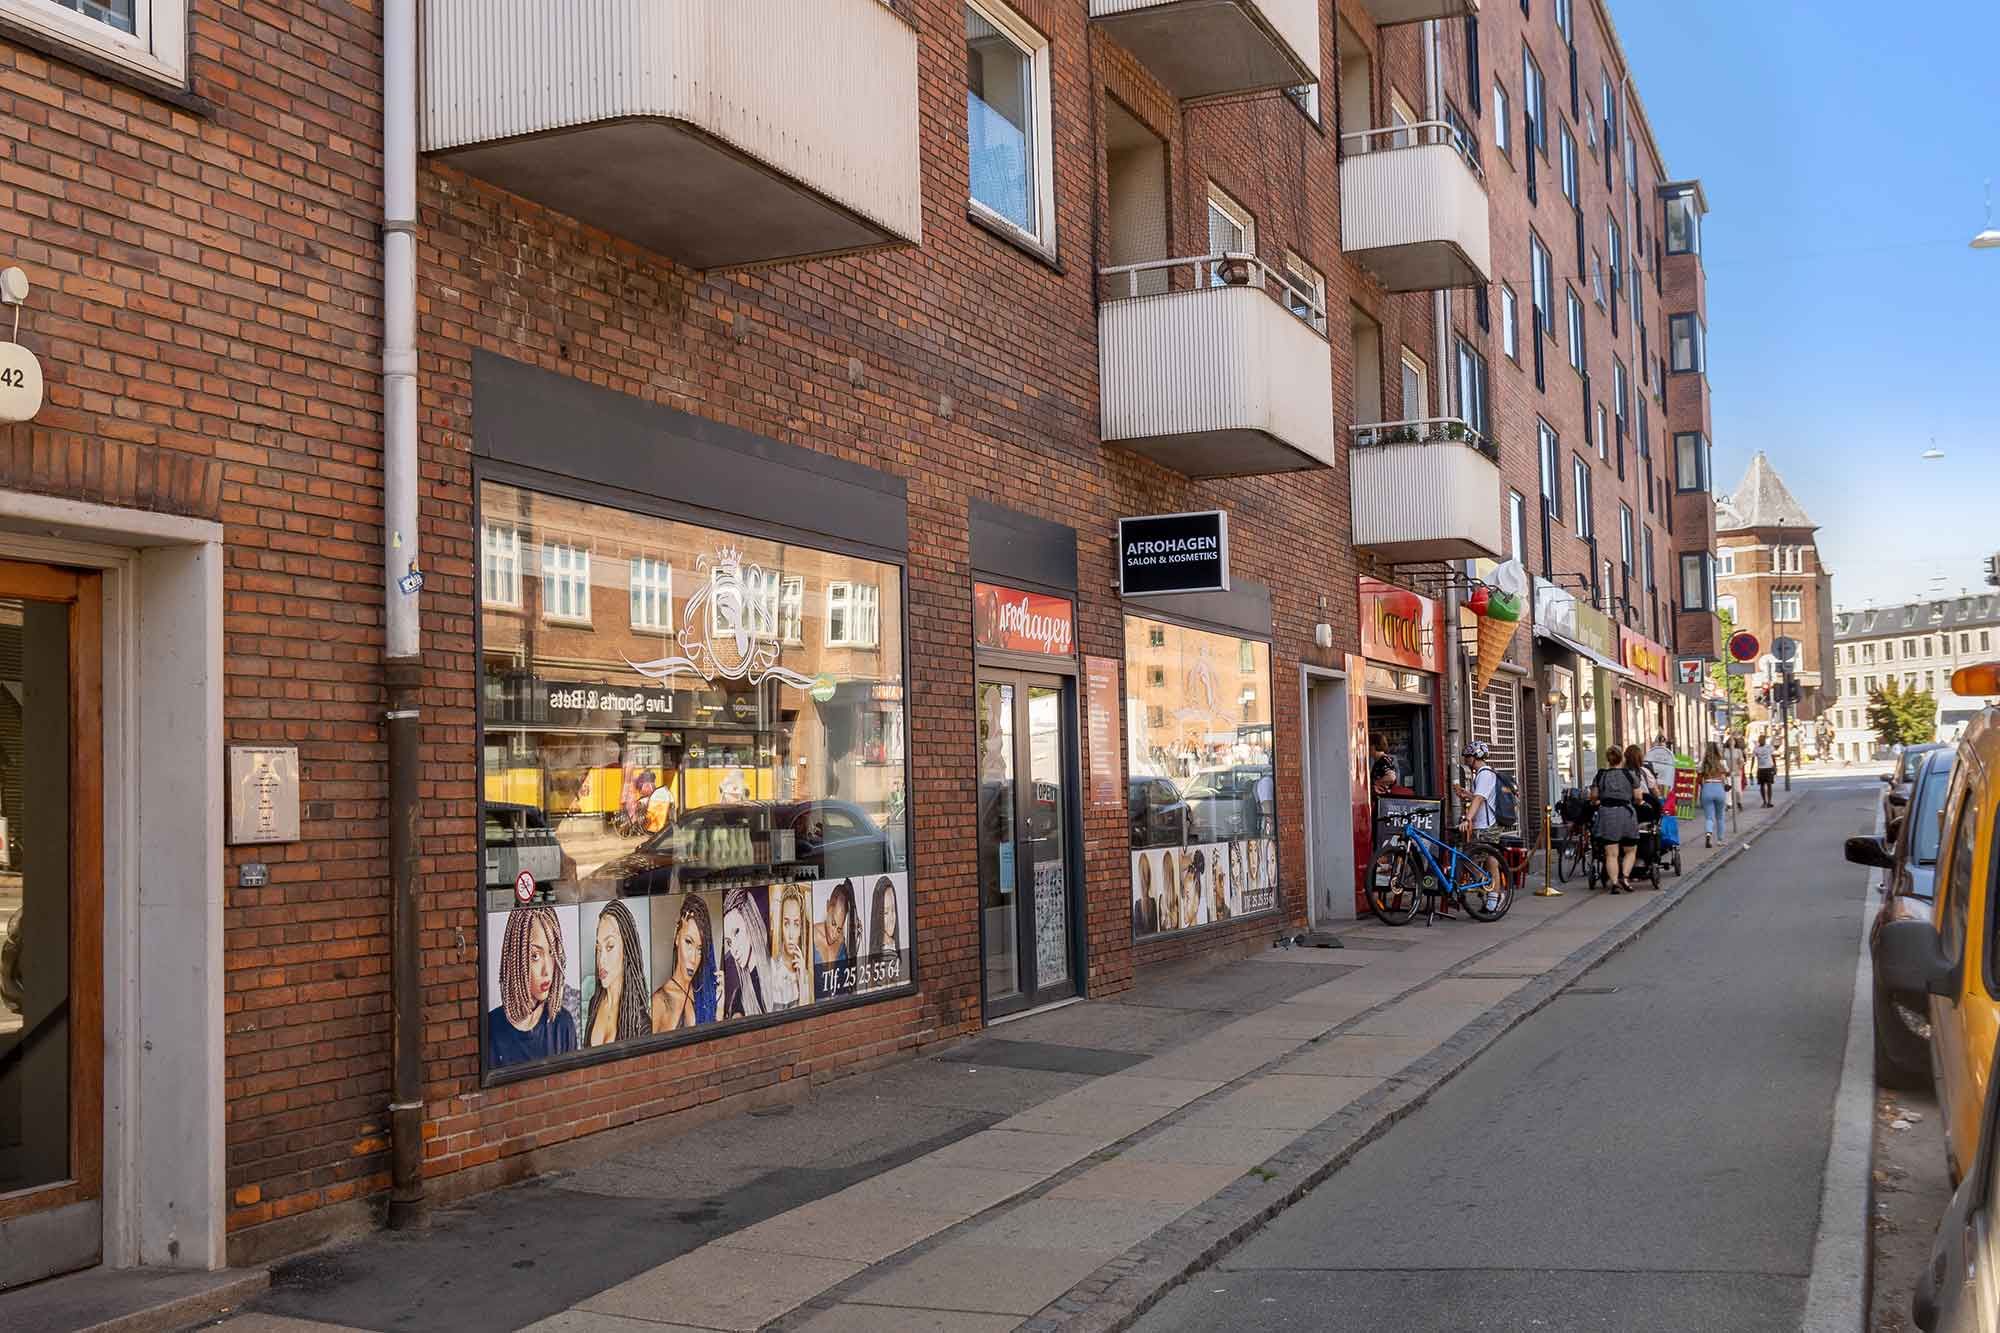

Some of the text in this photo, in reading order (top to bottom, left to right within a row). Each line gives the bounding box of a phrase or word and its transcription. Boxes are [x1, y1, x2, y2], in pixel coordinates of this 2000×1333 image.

[1, 367, 24, 388] 42
[1127, 536, 1217, 555] AFROHAGEN
[1127, 551, 1218, 566] SALON & KOSMETIKS
[822, 958, 900, 996] Tlf. 25 25 55 64
